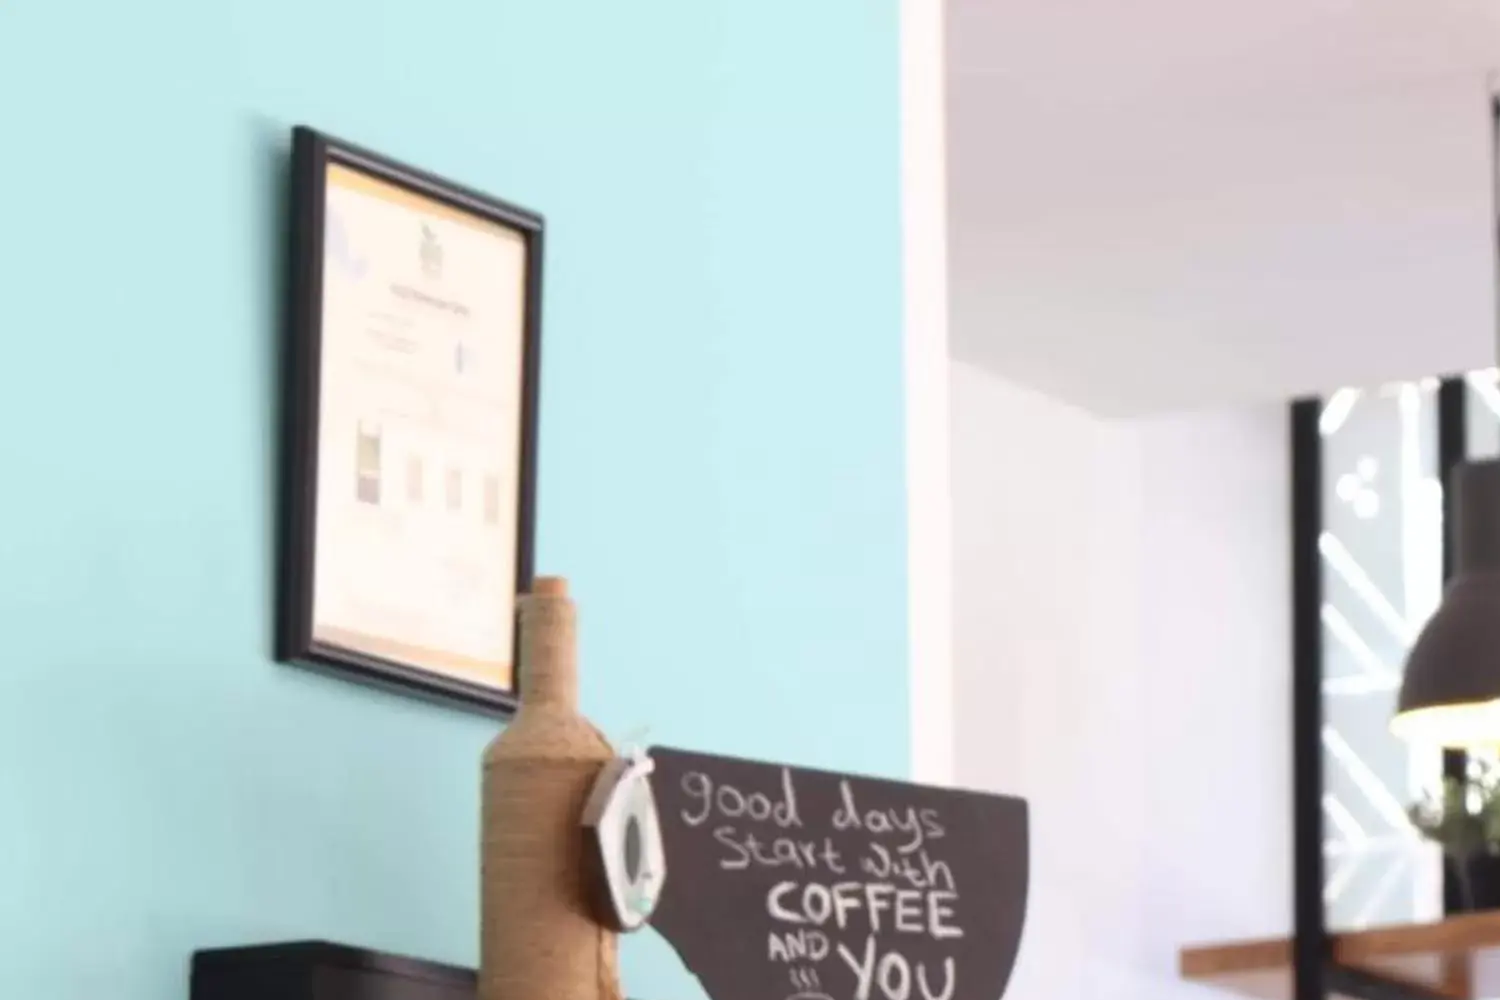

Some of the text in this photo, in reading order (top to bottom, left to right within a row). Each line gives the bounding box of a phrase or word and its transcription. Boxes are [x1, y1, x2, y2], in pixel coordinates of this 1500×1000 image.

[680, 766, 945, 853] good days
[860, 842, 956, 892] with
[766, 880, 965, 939] COFFEE
[767, 929, 829, 962] AND
